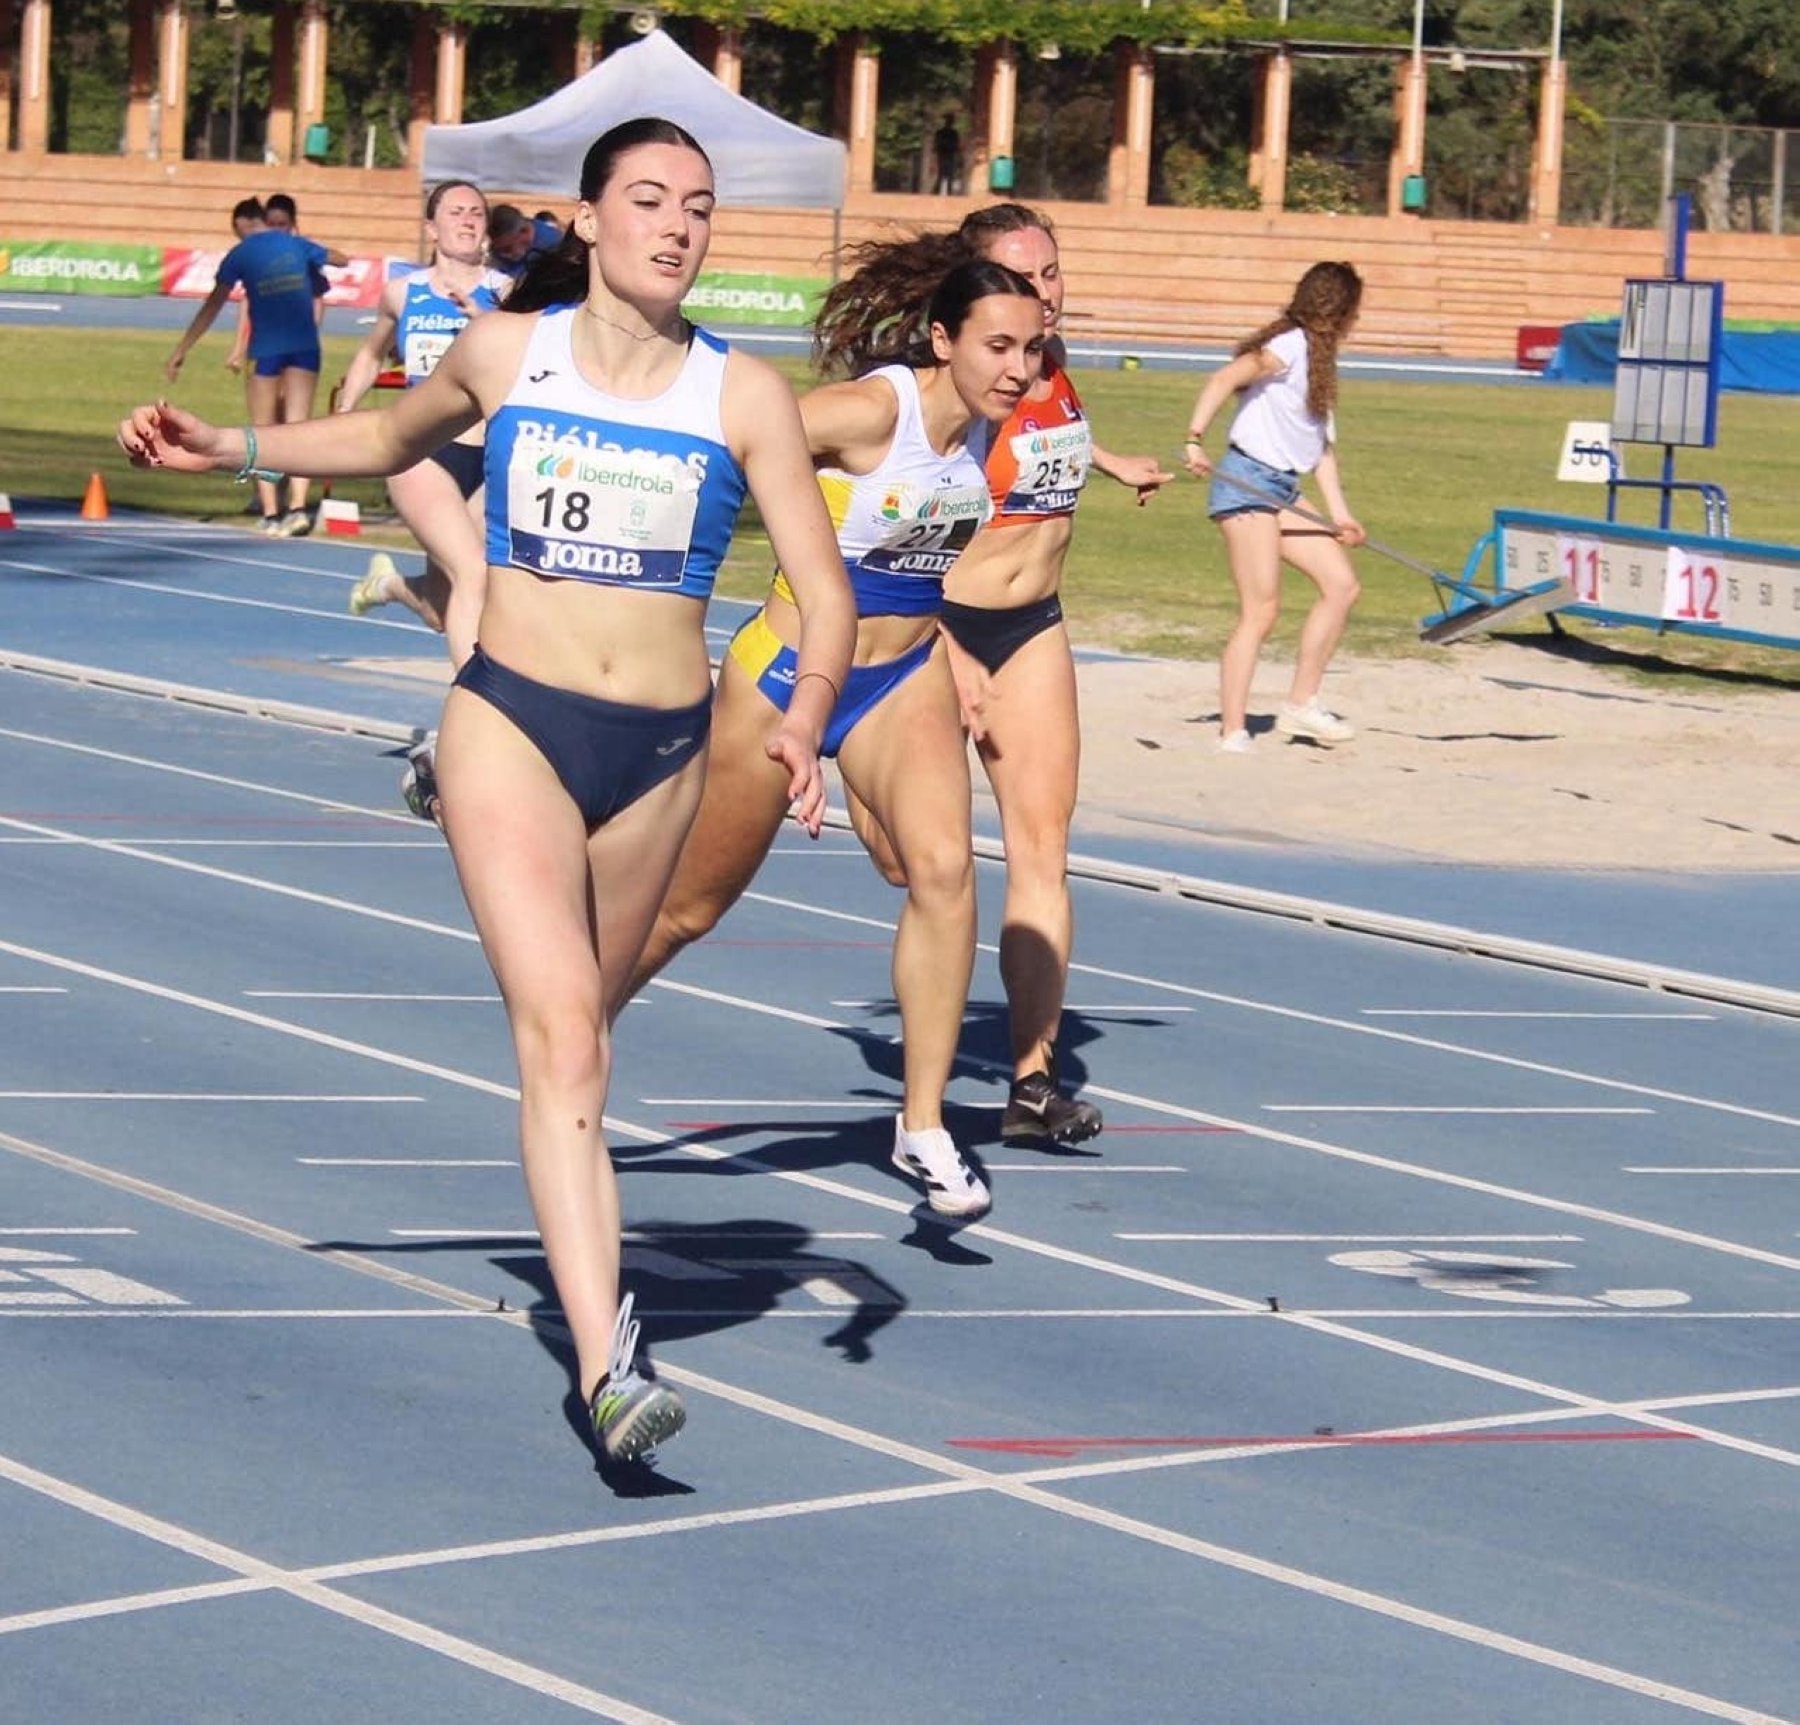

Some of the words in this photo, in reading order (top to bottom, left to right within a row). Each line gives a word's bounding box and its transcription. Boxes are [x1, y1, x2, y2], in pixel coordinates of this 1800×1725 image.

[12, 256, 141, 282] IBERDROLA
[681, 287, 805, 312] BERDROLA
[1032, 458, 1062, 489] 25
[535, 486, 591, 533] 18
[896, 523, 946, 549] 27
[1564, 547, 1600, 602] 11
[1677, 564, 1721, 620] 12
